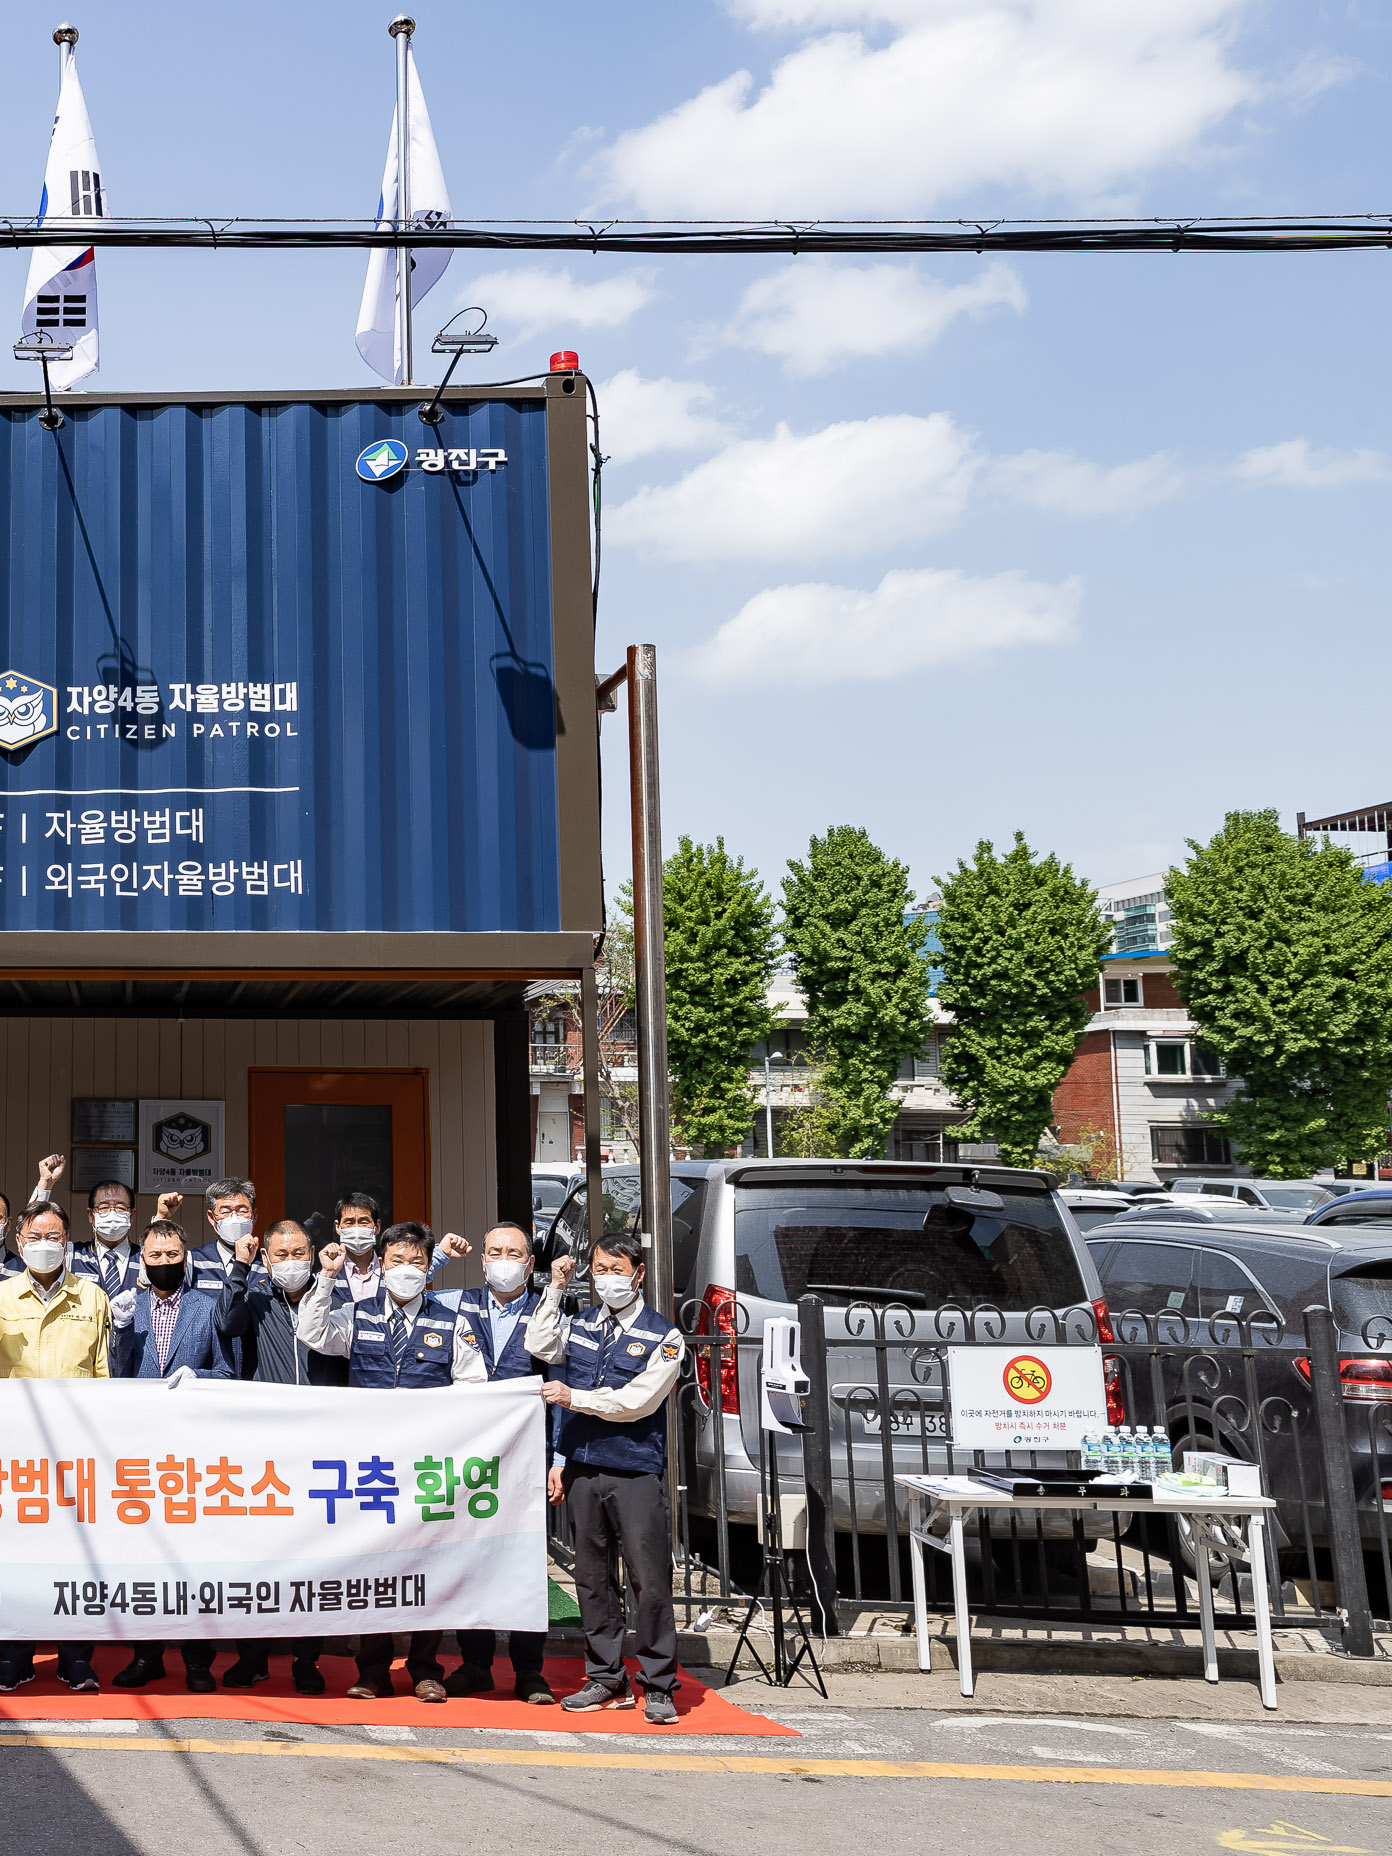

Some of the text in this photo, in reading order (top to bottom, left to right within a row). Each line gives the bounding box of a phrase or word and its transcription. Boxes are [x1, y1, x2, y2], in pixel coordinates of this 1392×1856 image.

[415, 448, 508, 471] 광진구
[66, 681, 298, 715] 자양4동 자율방범대
[66, 721, 298, 741] CITIZEN PATROL
[44, 807, 204, 845] 자율방범대
[44, 859, 303, 898] 외국인자율방범대
[960, 1409, 983, 1418] 이곳에
[984, 1409, 1013, 1419] 자전거를
[1014, 1409, 1044, 1419] 방치하지
[1045, 1409, 1067, 1418] 마시기
[995, 1422, 1067, 1431] 방치시 즉시 수거 처분
[111, 1453, 295, 1525] 통합초소
[308, 1454, 400, 1525] 구축
[413, 1454, 501, 1523] 환영
[289, 1573, 426, 1614] 자율방범대
